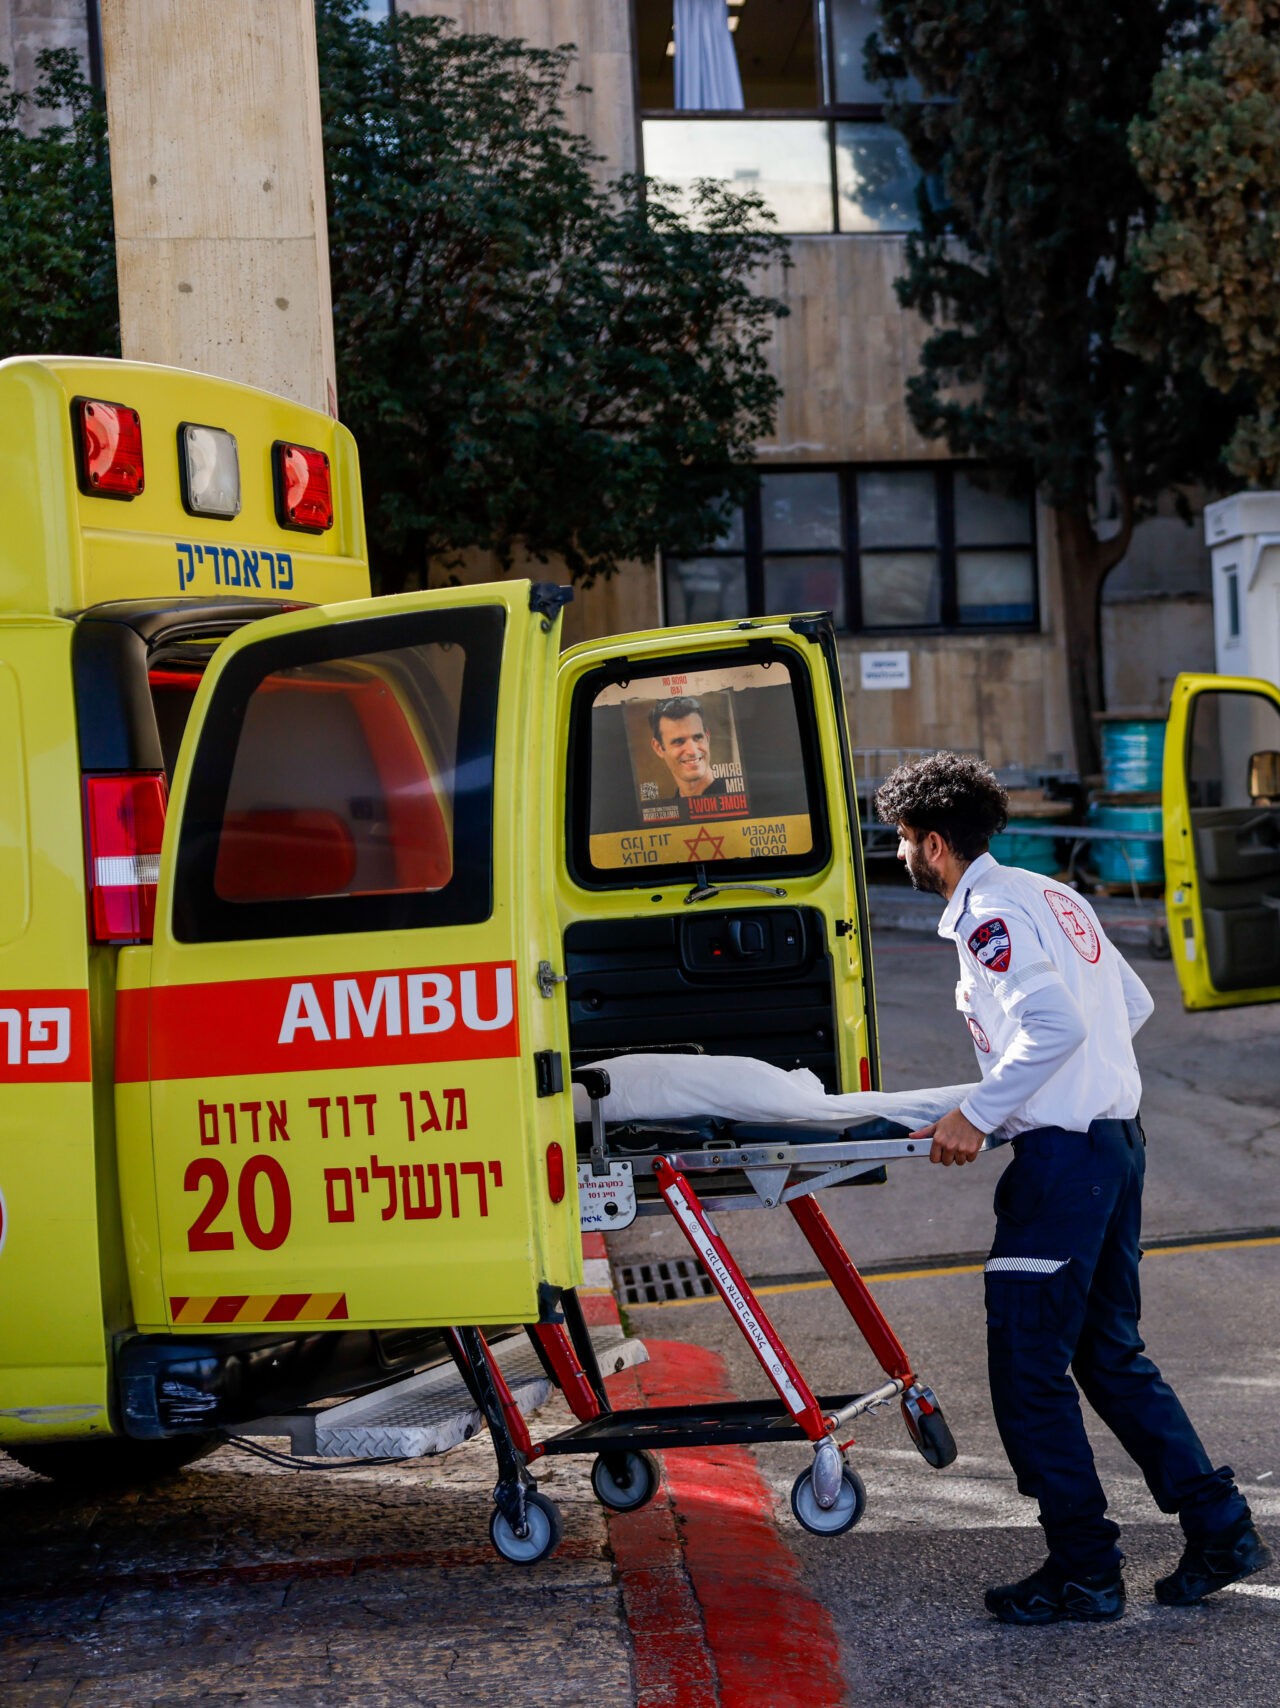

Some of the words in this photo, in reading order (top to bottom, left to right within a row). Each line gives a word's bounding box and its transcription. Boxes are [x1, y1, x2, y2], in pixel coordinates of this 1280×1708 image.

[175, 542, 294, 591] פראמדיק
[278, 967, 514, 1045] AMBU
[198, 1098, 291, 1147] אדום
[308, 1094, 377, 1140] דוד
[400, 1088, 468, 1142] מגן
[183, 1154, 292, 1253] 20
[324, 1155, 504, 1224] ירושלים
[705, 1248, 720, 1266] מגן
[715, 1267, 728, 1284] דוד
[726, 1283, 744, 1310] אדום
[742, 1310, 767, 1350] בישראל
